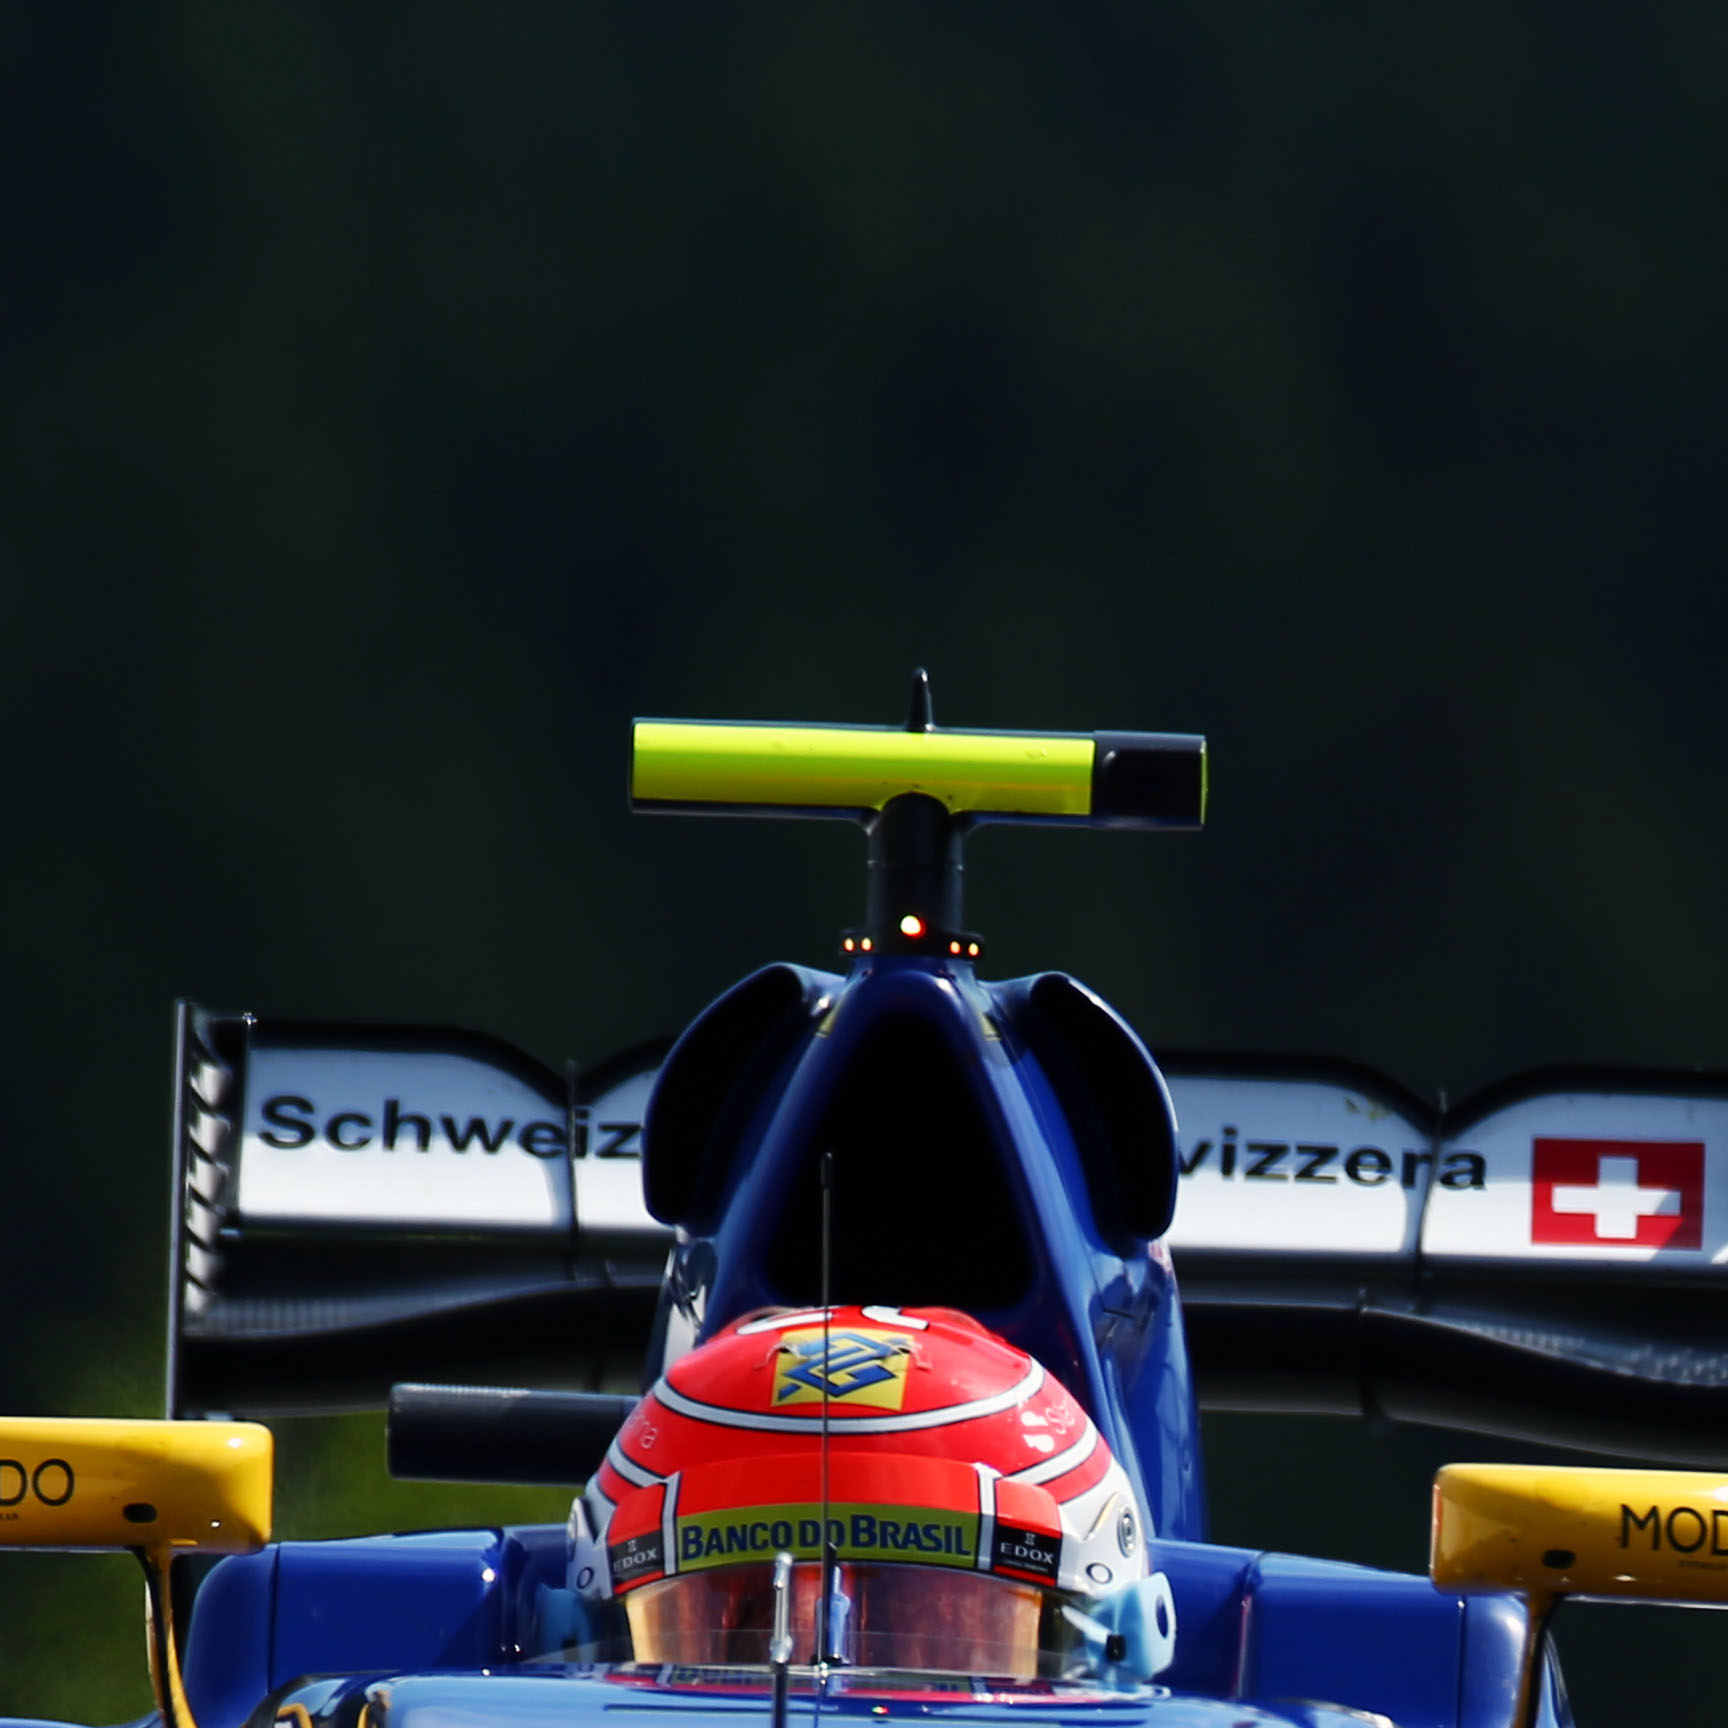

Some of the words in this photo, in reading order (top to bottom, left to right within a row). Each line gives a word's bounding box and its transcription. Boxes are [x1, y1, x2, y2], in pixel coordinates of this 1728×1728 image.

[258, 1094, 642, 1161] Schweiz
[1177, 1125, 1487, 1190] vizzera
[681, 1520, 793, 1561] BANCO
[798, 1519, 846, 1549] DO
[850, 1514, 971, 1556] BRASIL
[1000, 1542, 1054, 1565] EDOX
